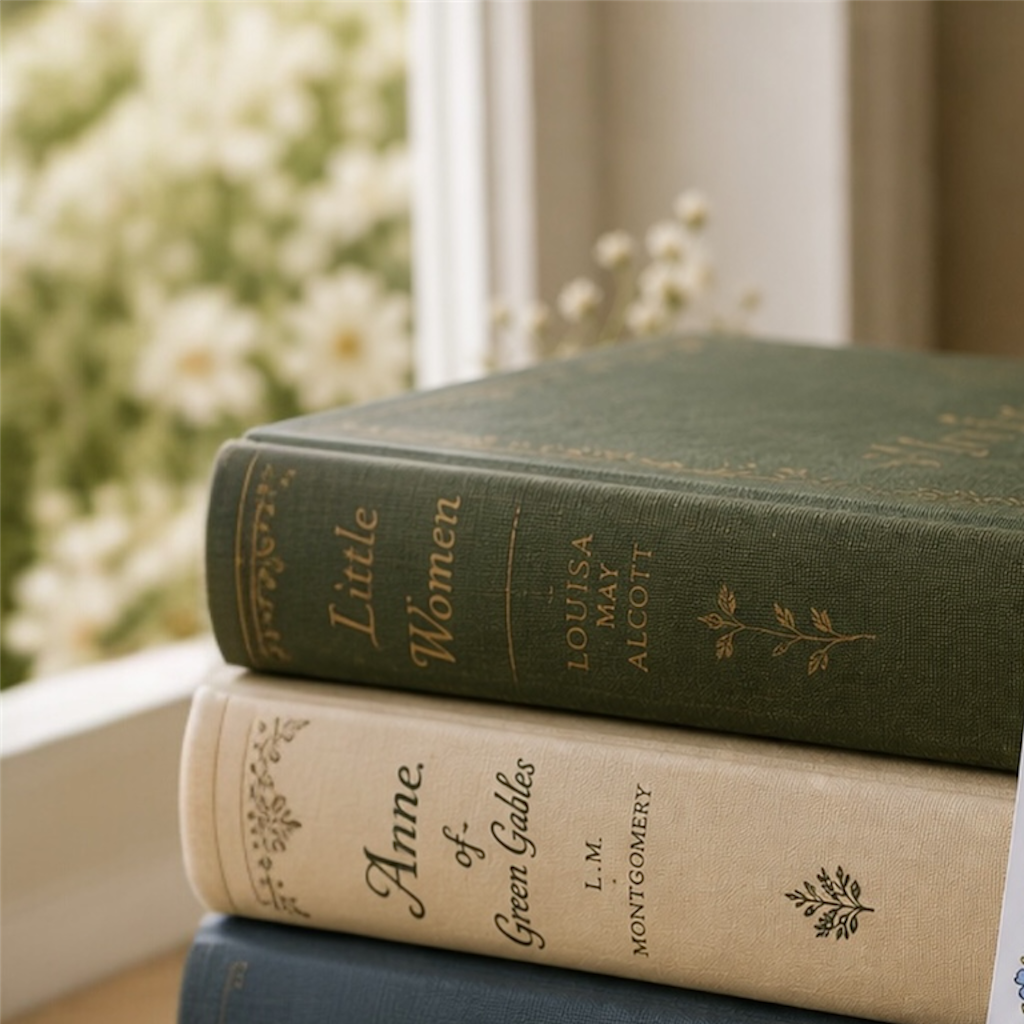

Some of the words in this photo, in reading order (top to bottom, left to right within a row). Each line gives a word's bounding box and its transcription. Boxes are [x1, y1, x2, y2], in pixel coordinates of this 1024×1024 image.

[328, 506, 379, 649] Little
[405, 495, 462, 668] Women
[565, 534, 594, 672] LOUISA
[596, 563, 619, 629] MAY
[627, 543, 652, 673] ALCOTT
[490, 757, 537, 858] Gables
[628, 782, 652, 958] MONTGOMERY
[494, 864, 546, 950] Green
